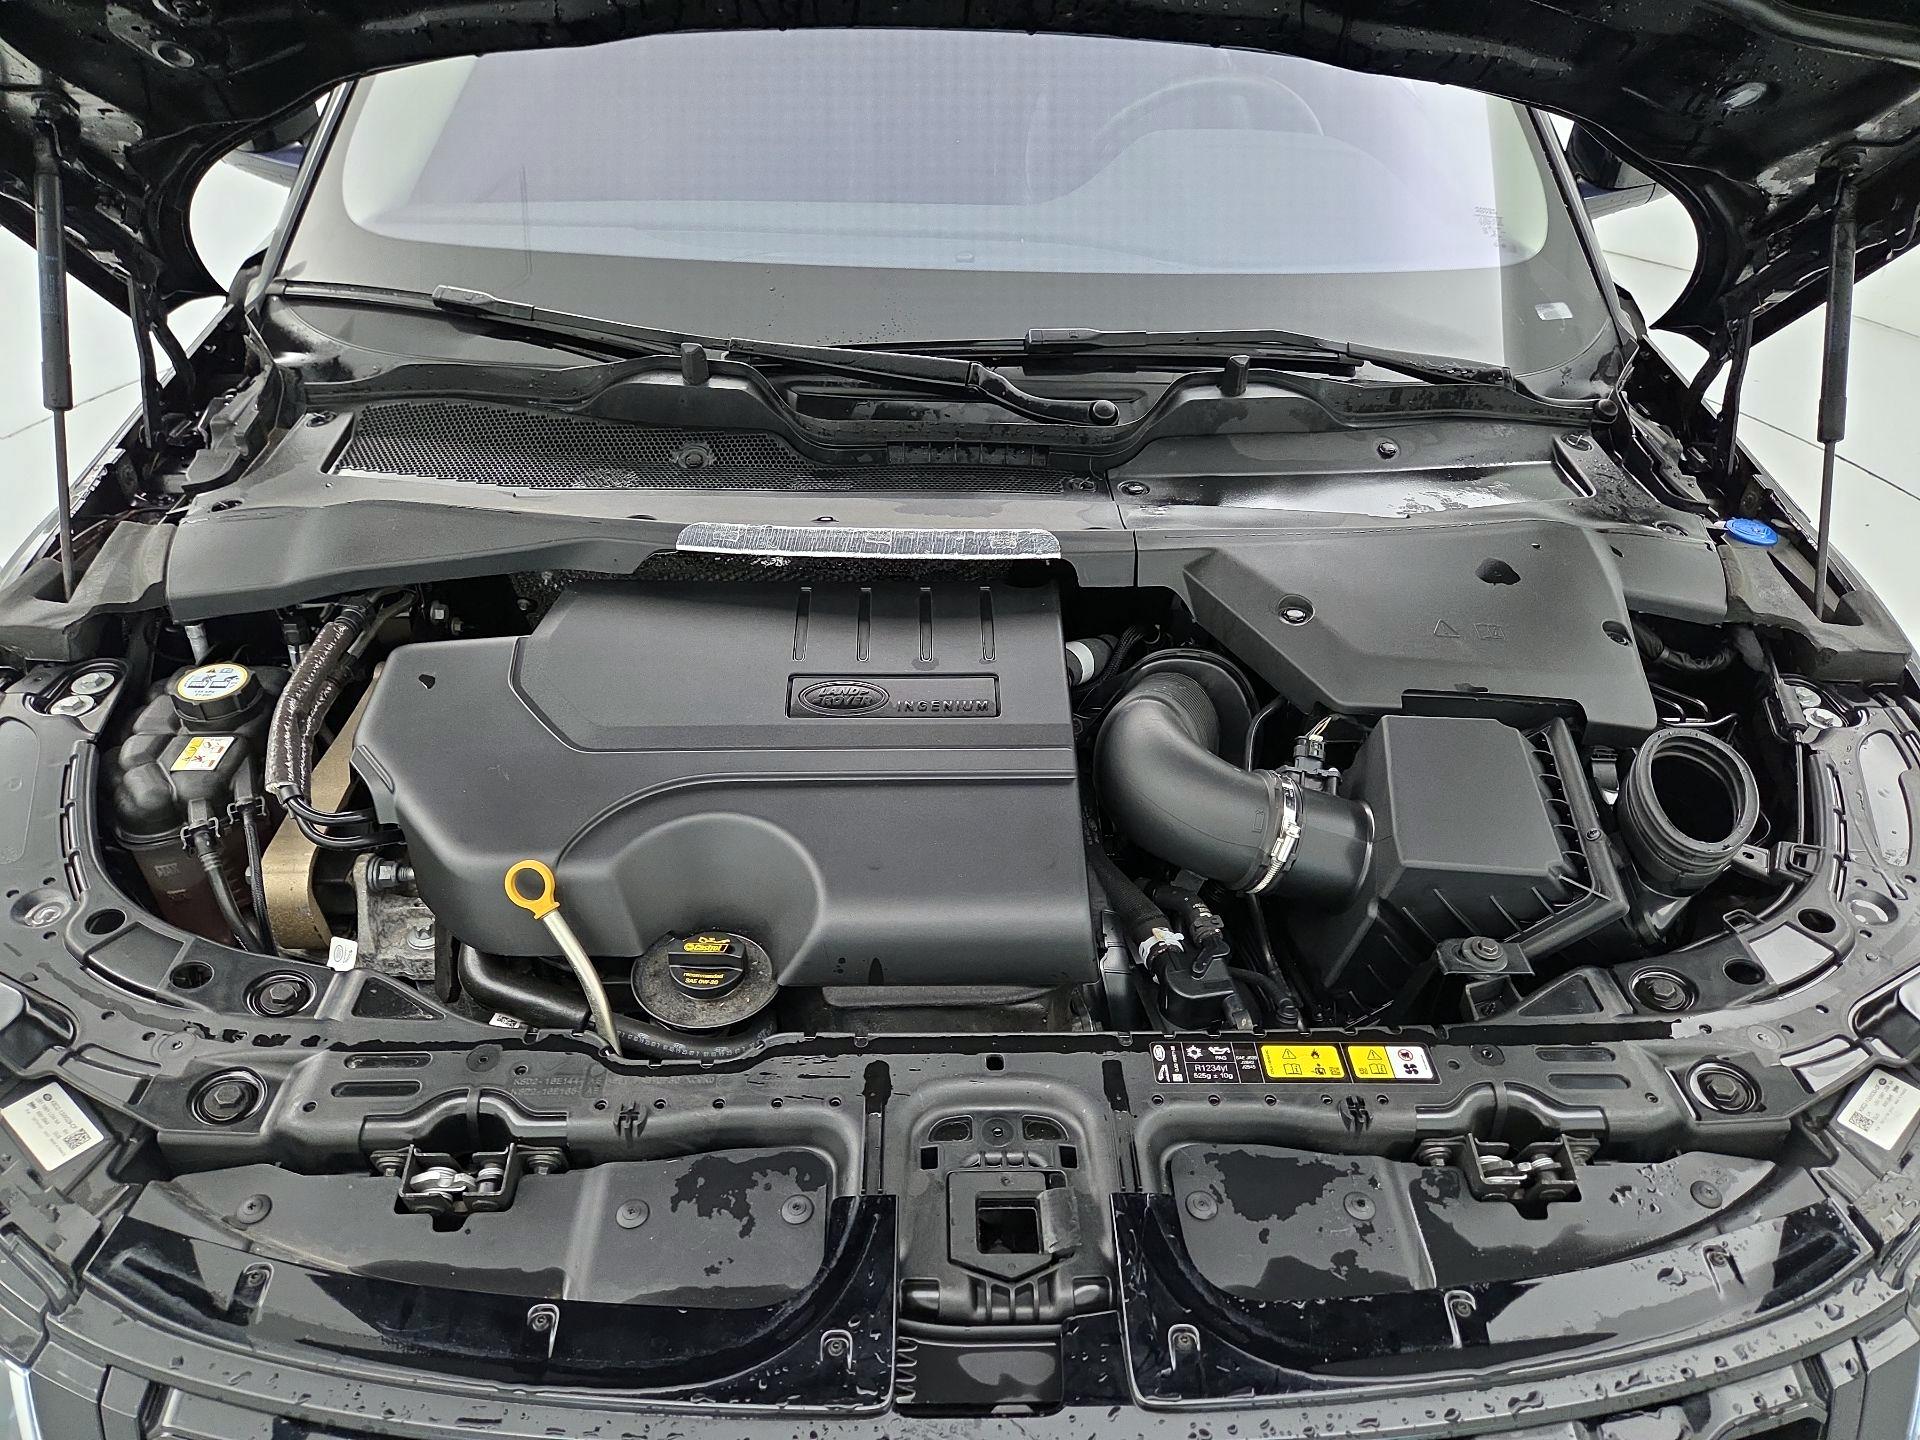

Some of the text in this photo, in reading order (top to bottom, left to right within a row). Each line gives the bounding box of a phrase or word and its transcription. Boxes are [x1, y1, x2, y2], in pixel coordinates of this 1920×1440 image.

[818, 686, 862, 696] LAND
[822, 696, 872, 706] ROVER
[896, 700, 989, 713] INGENIUM
[1194, 1064, 1228, 1073] R1234yf
